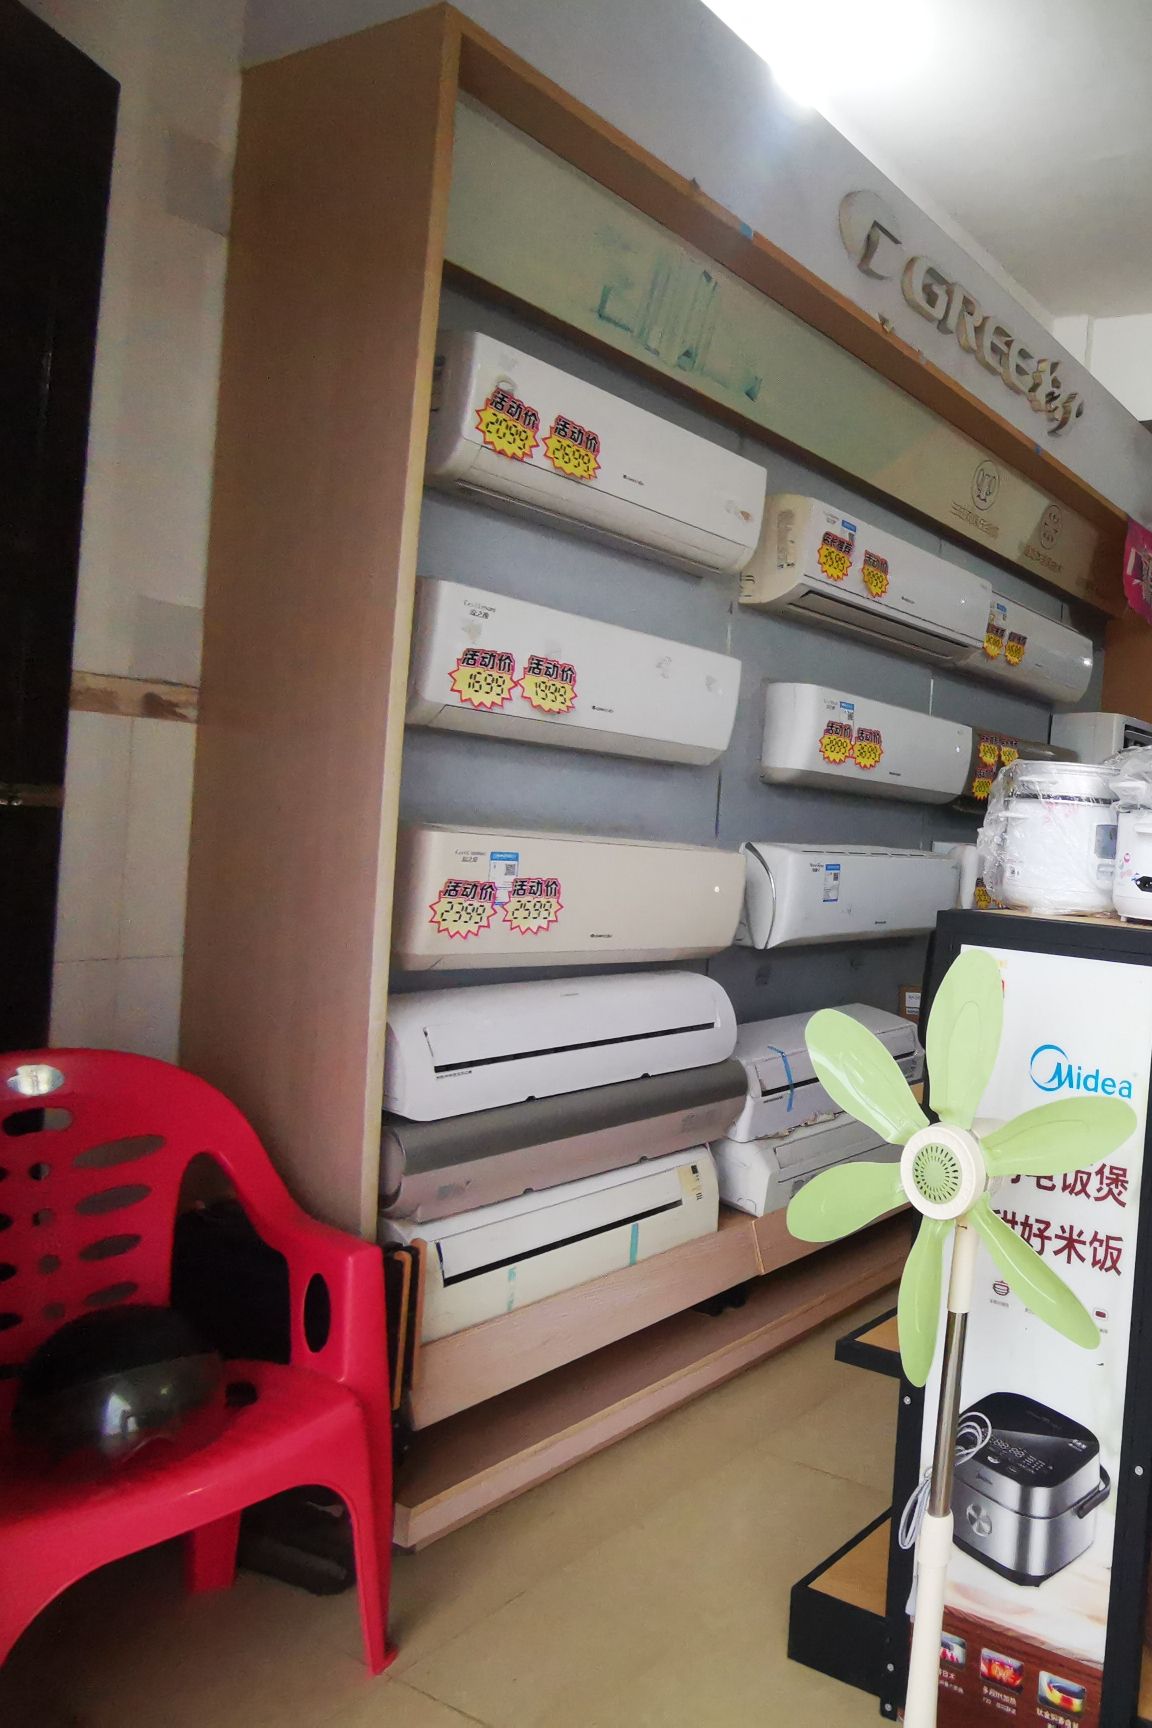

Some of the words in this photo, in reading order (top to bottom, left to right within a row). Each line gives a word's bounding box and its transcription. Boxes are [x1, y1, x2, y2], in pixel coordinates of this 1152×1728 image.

[490, 392, 538, 430] 活动价
[554, 418, 598, 453] 活动价
[462, 650, 513, 673] 活动价
[528, 657, 575, 684] 活动价
[468, 671, 506, 696] 1699
[443, 881, 495, 901] 活动价
[512, 880, 559, 897] 活动价
[440, 901, 486, 924] 2399
[511, 900, 553, 920] 2599
[1036, 1052, 1133, 1100] Midea
[1011, 1163, 1129, 1208] 饭煲
